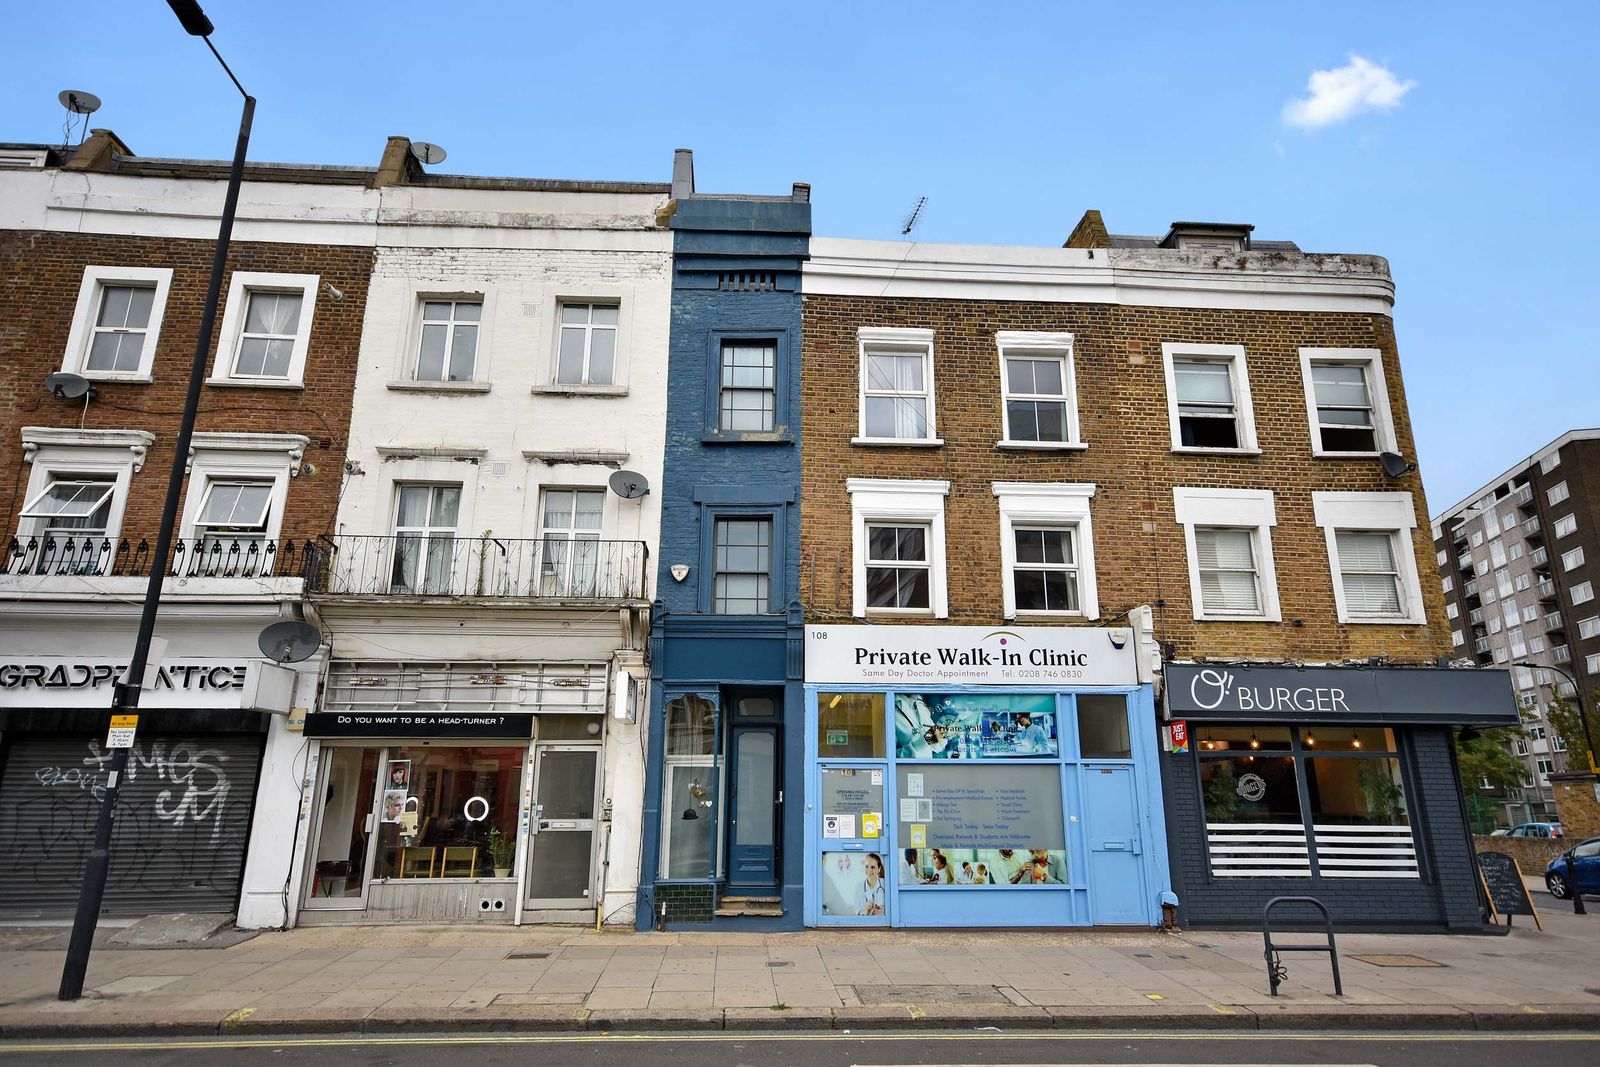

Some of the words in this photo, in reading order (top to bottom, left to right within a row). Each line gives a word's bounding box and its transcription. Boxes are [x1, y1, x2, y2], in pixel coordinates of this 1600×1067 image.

[811, 631, 828, 640] 108
[854, 647, 932, 666] Private
[937, 647, 1023, 666] Walk-In
[1028, 648, 1089, 667] Clinic
[0, 663, 248, 690] GRADPNTICE
[862, 668, 885, 677] Same
[887, 669, 904, 679] Day
[907, 669, 934, 677] Doctor
[936, 670, 989, 679] Appointment
[1001, 669, 1016, 678] Tel:
[1018, 670, 1040, 678] 0208
[1043, 670, 1058, 678] 746
[1060, 670, 1083, 678] 0830
[1237, 687, 1350, 712] BURGER
[438, 717, 497, 725] HEAD-TURNER
[499, 716, 505, 725] ?
[1172, 723, 1184, 735] JUST
[1175, 732, 1185, 741] EAT
